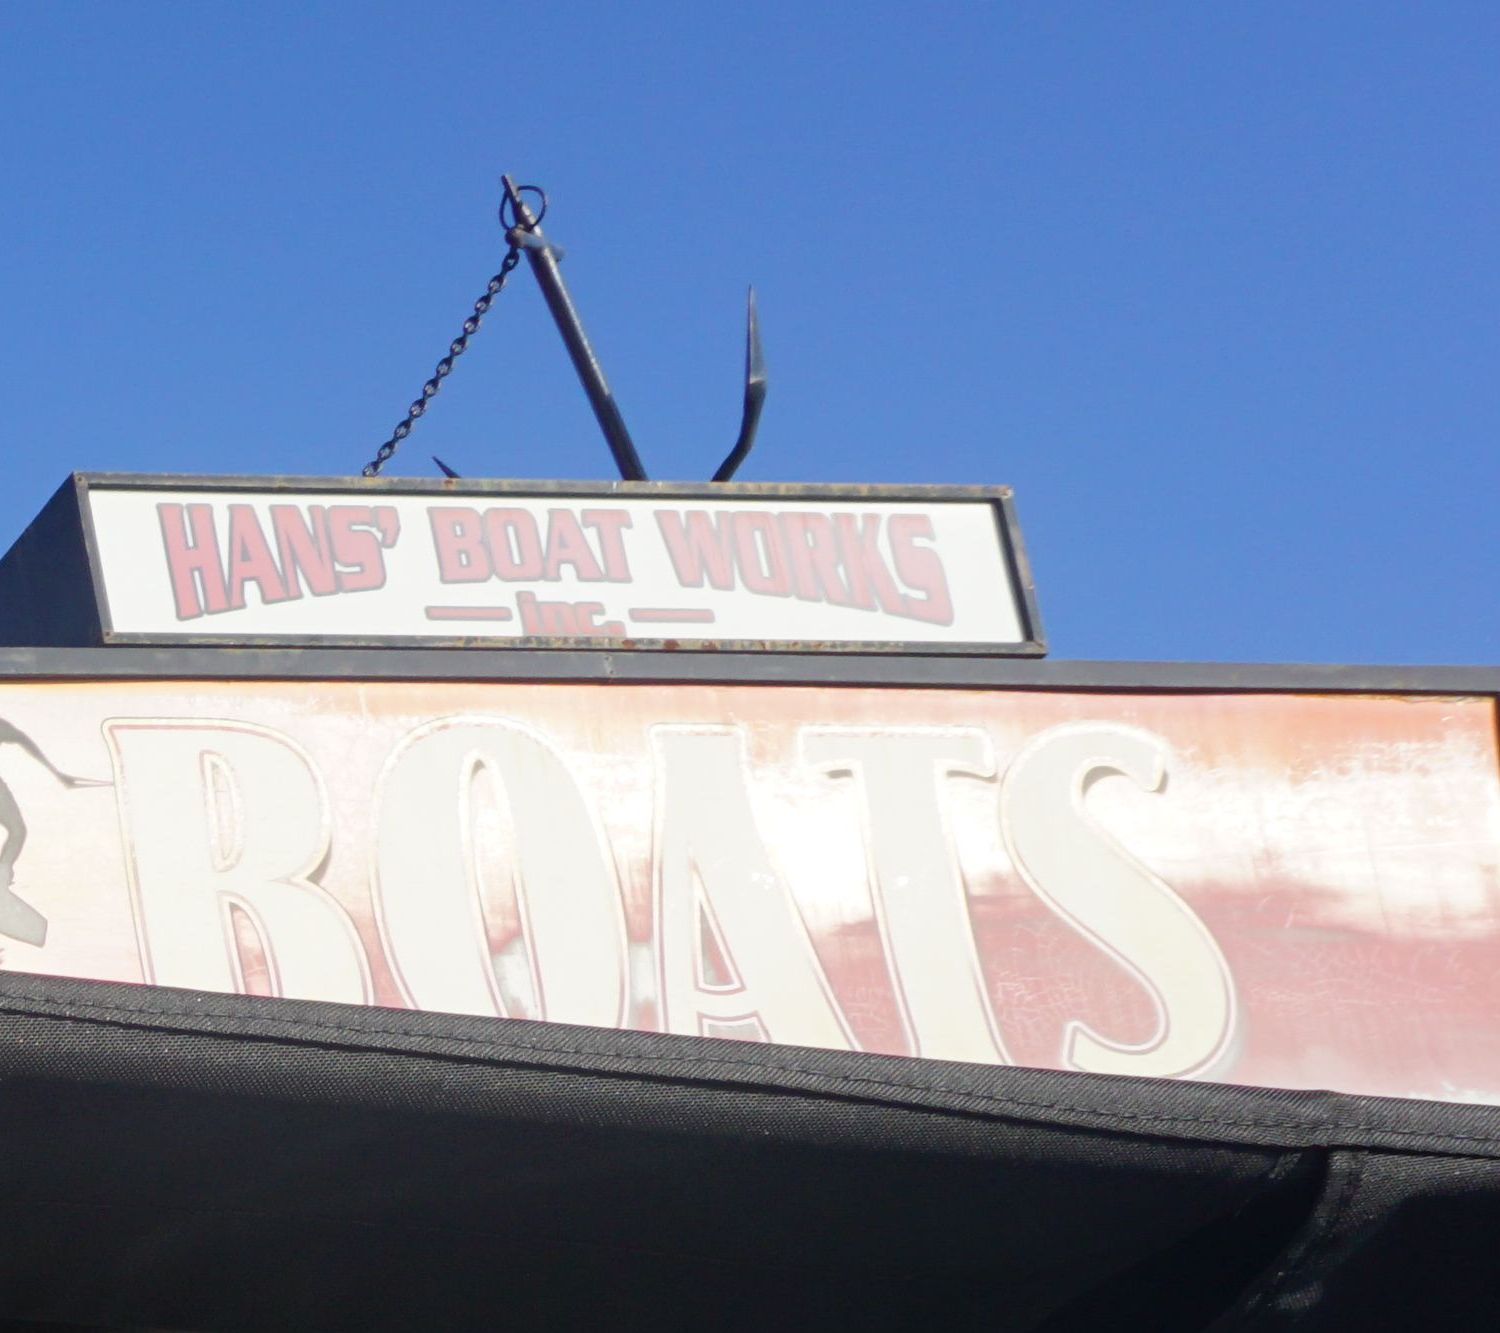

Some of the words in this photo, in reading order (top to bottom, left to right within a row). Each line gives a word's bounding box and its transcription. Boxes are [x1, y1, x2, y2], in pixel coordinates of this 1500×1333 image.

[156, 502, 402, 621] HANS'
[428, 506, 633, 585] BOAT
[653, 509, 955, 627] WORKS
[102, 713, 1238, 1080] BOATS
